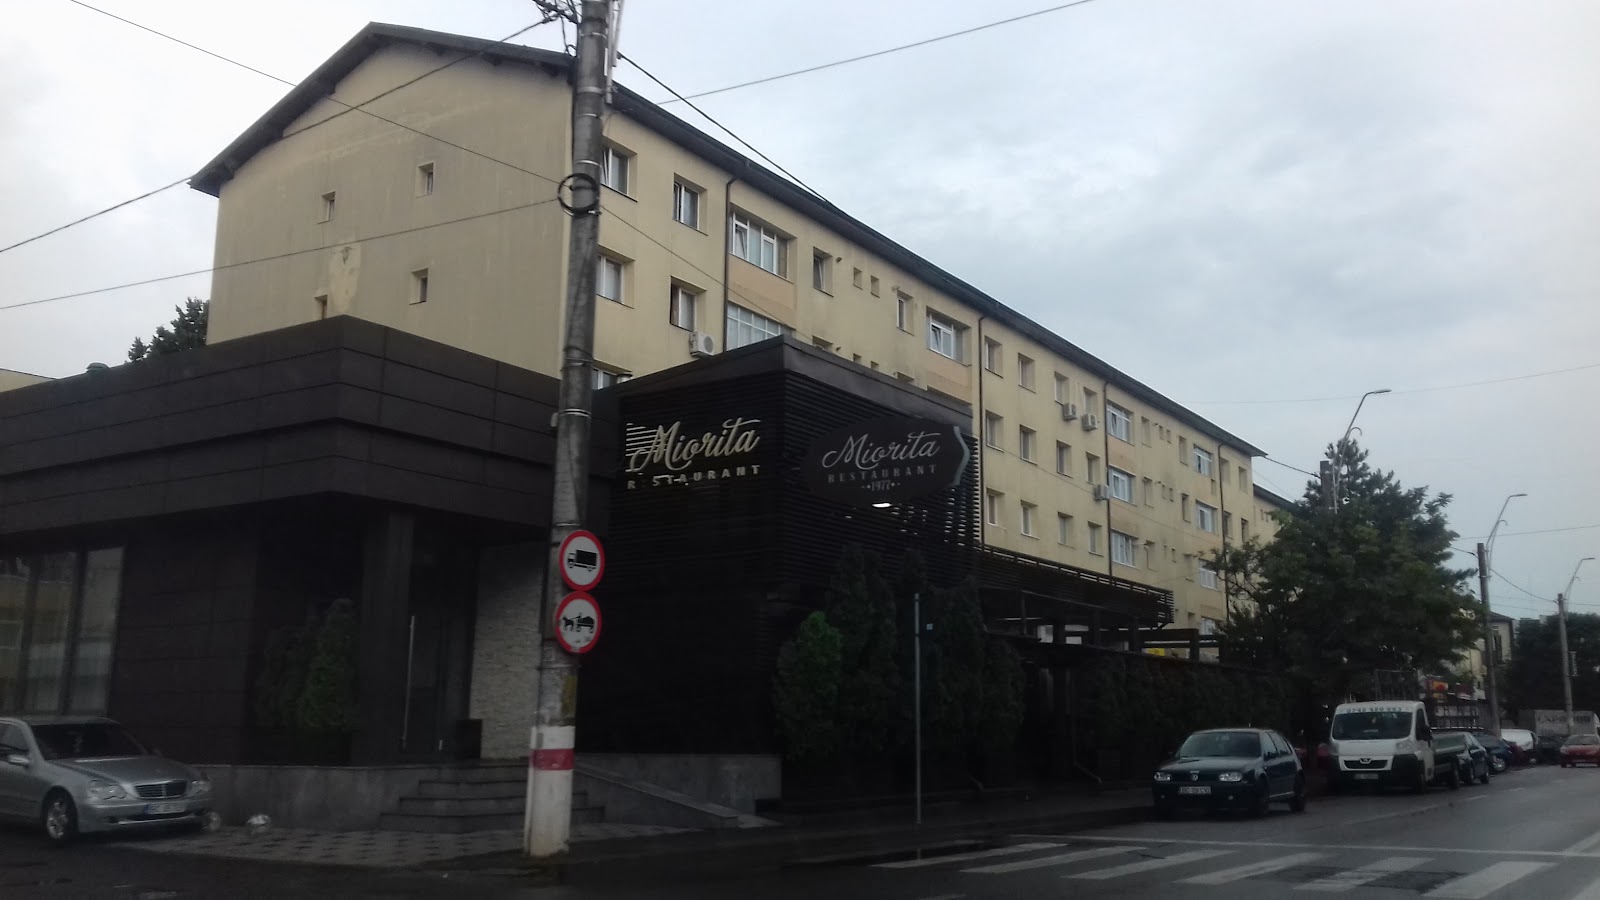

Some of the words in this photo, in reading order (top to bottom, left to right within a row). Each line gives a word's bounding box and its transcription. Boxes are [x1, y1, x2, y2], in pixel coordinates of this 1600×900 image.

[628, 417, 761, 471] Miorita
[822, 431, 942, 470] Miorita
[627, 465, 760, 490] RSTAURANT
[828, 464, 937, 483] RESTAURANT
[871, 480, 891, 491] 1977
